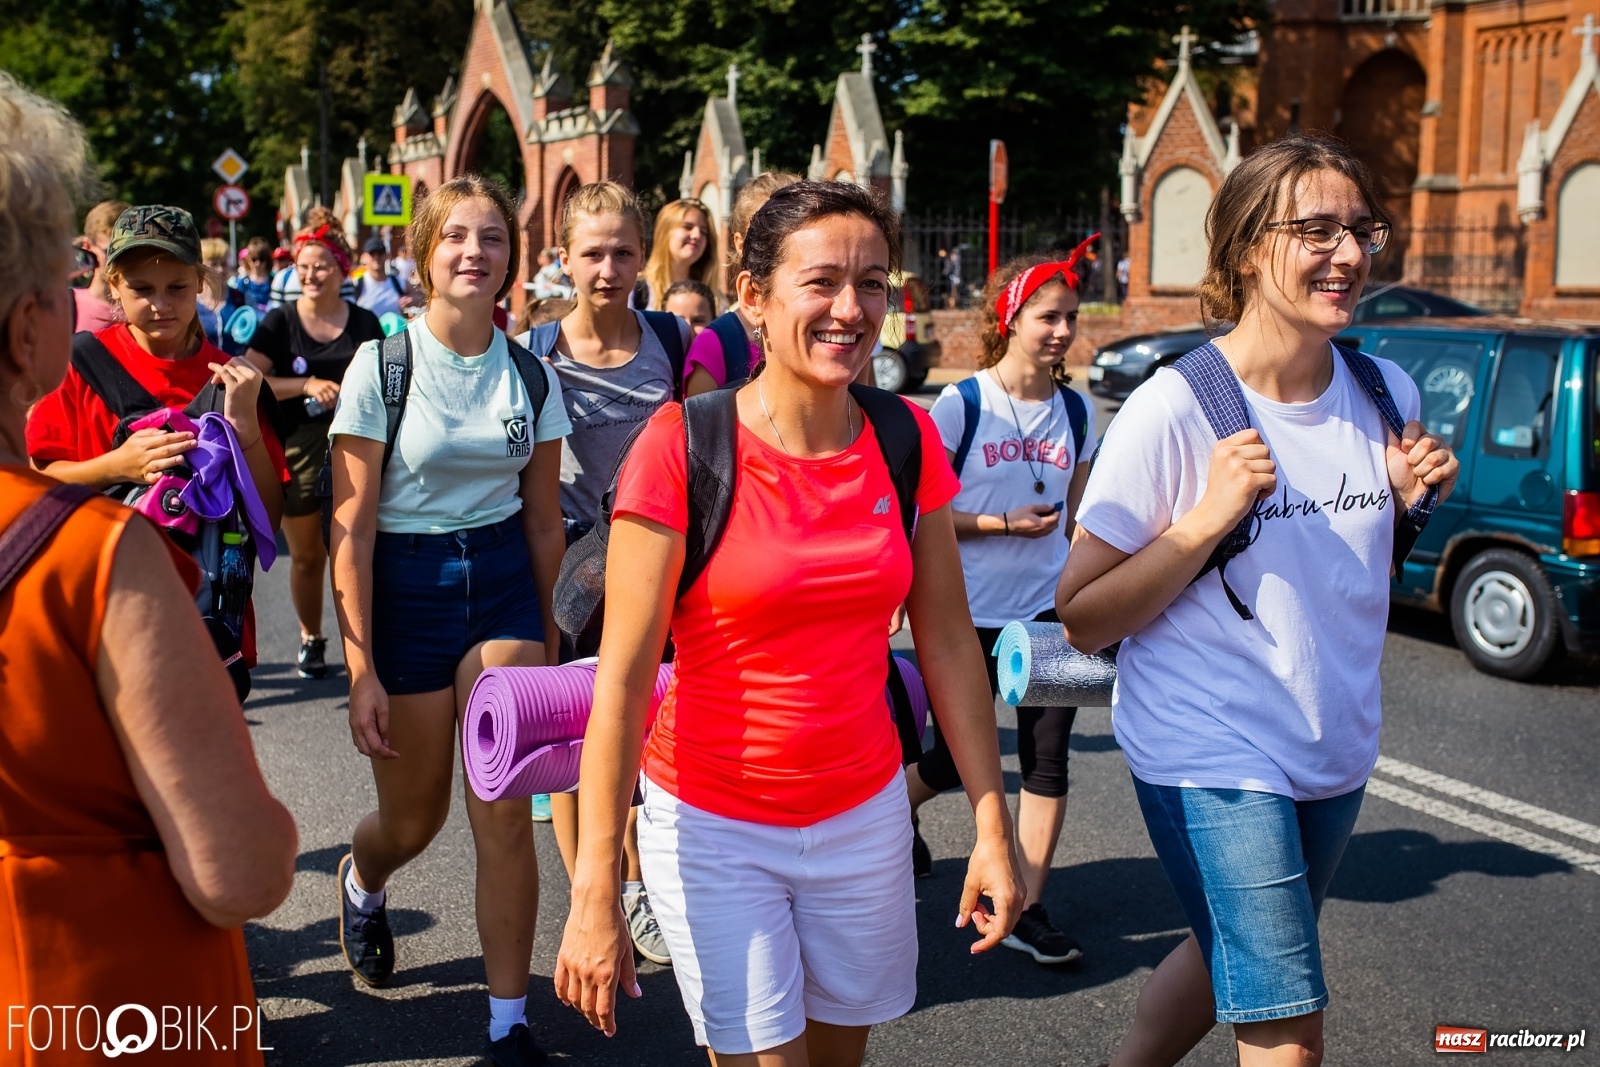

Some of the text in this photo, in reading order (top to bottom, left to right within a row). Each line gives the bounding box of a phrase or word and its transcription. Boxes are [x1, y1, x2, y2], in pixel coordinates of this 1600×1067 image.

[134, 209, 174, 237] K
[587, 397, 603, 408] be
[586, 420, 611, 430] and
[508, 443, 530, 457] VANS
[982, 436, 1072, 471] BORED
